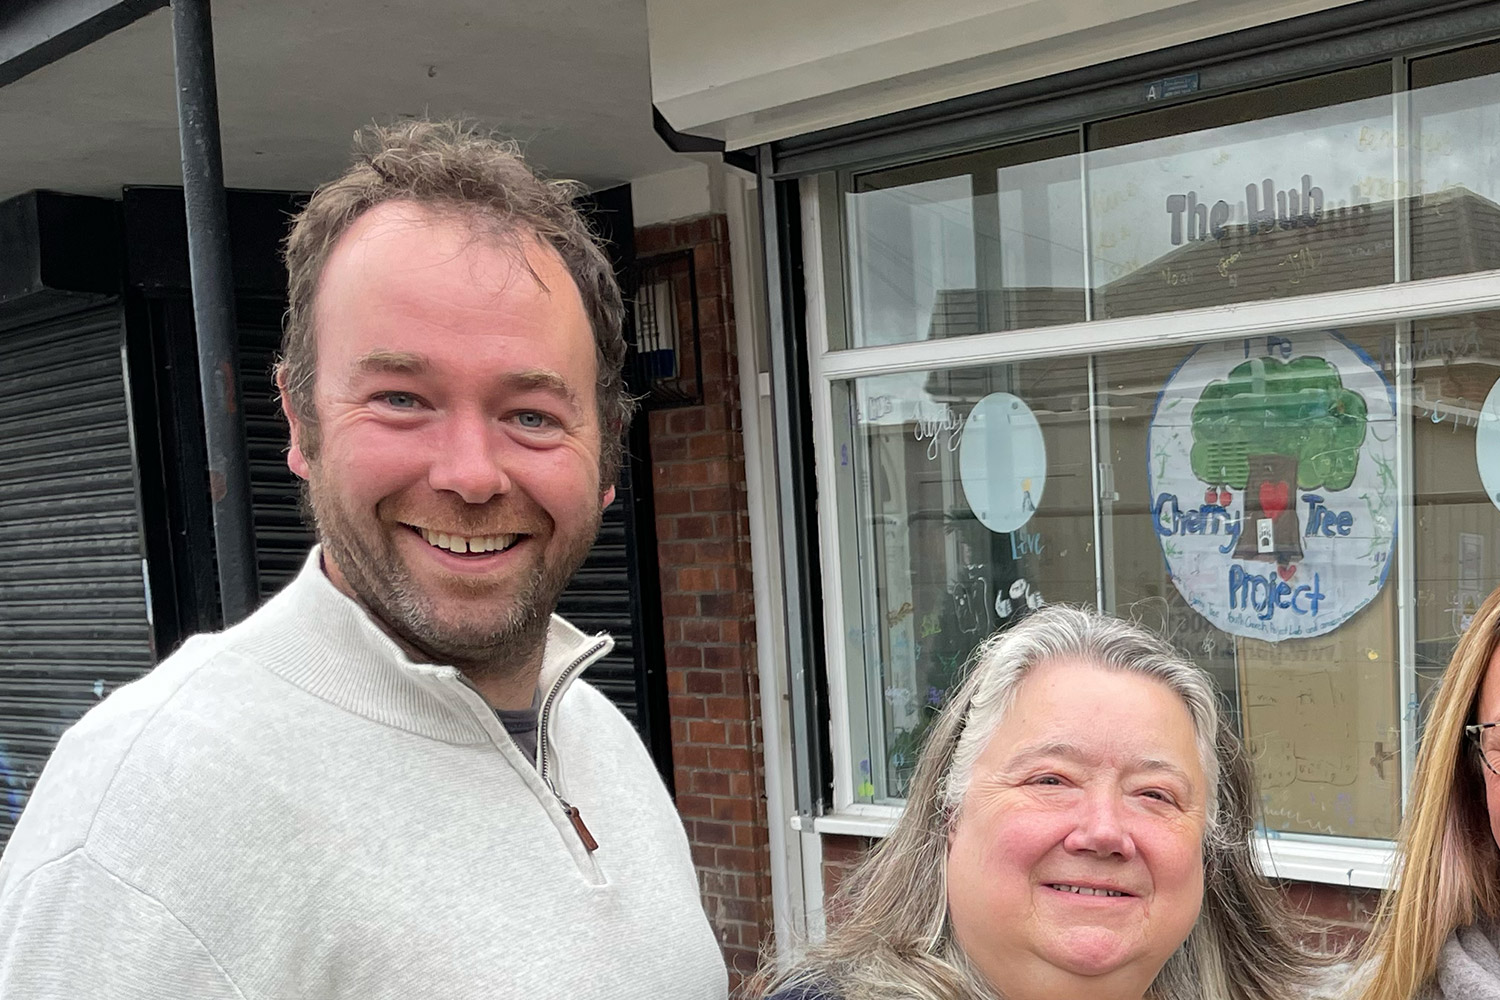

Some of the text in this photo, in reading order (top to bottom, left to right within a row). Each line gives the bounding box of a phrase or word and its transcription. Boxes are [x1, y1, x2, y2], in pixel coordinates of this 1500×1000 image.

[1166, 190, 1230, 245] The
[1246, 173, 1323, 235] Hub
[1155, 492, 1354, 554] Cherry Tree
[1228, 565, 1325, 621] Project
